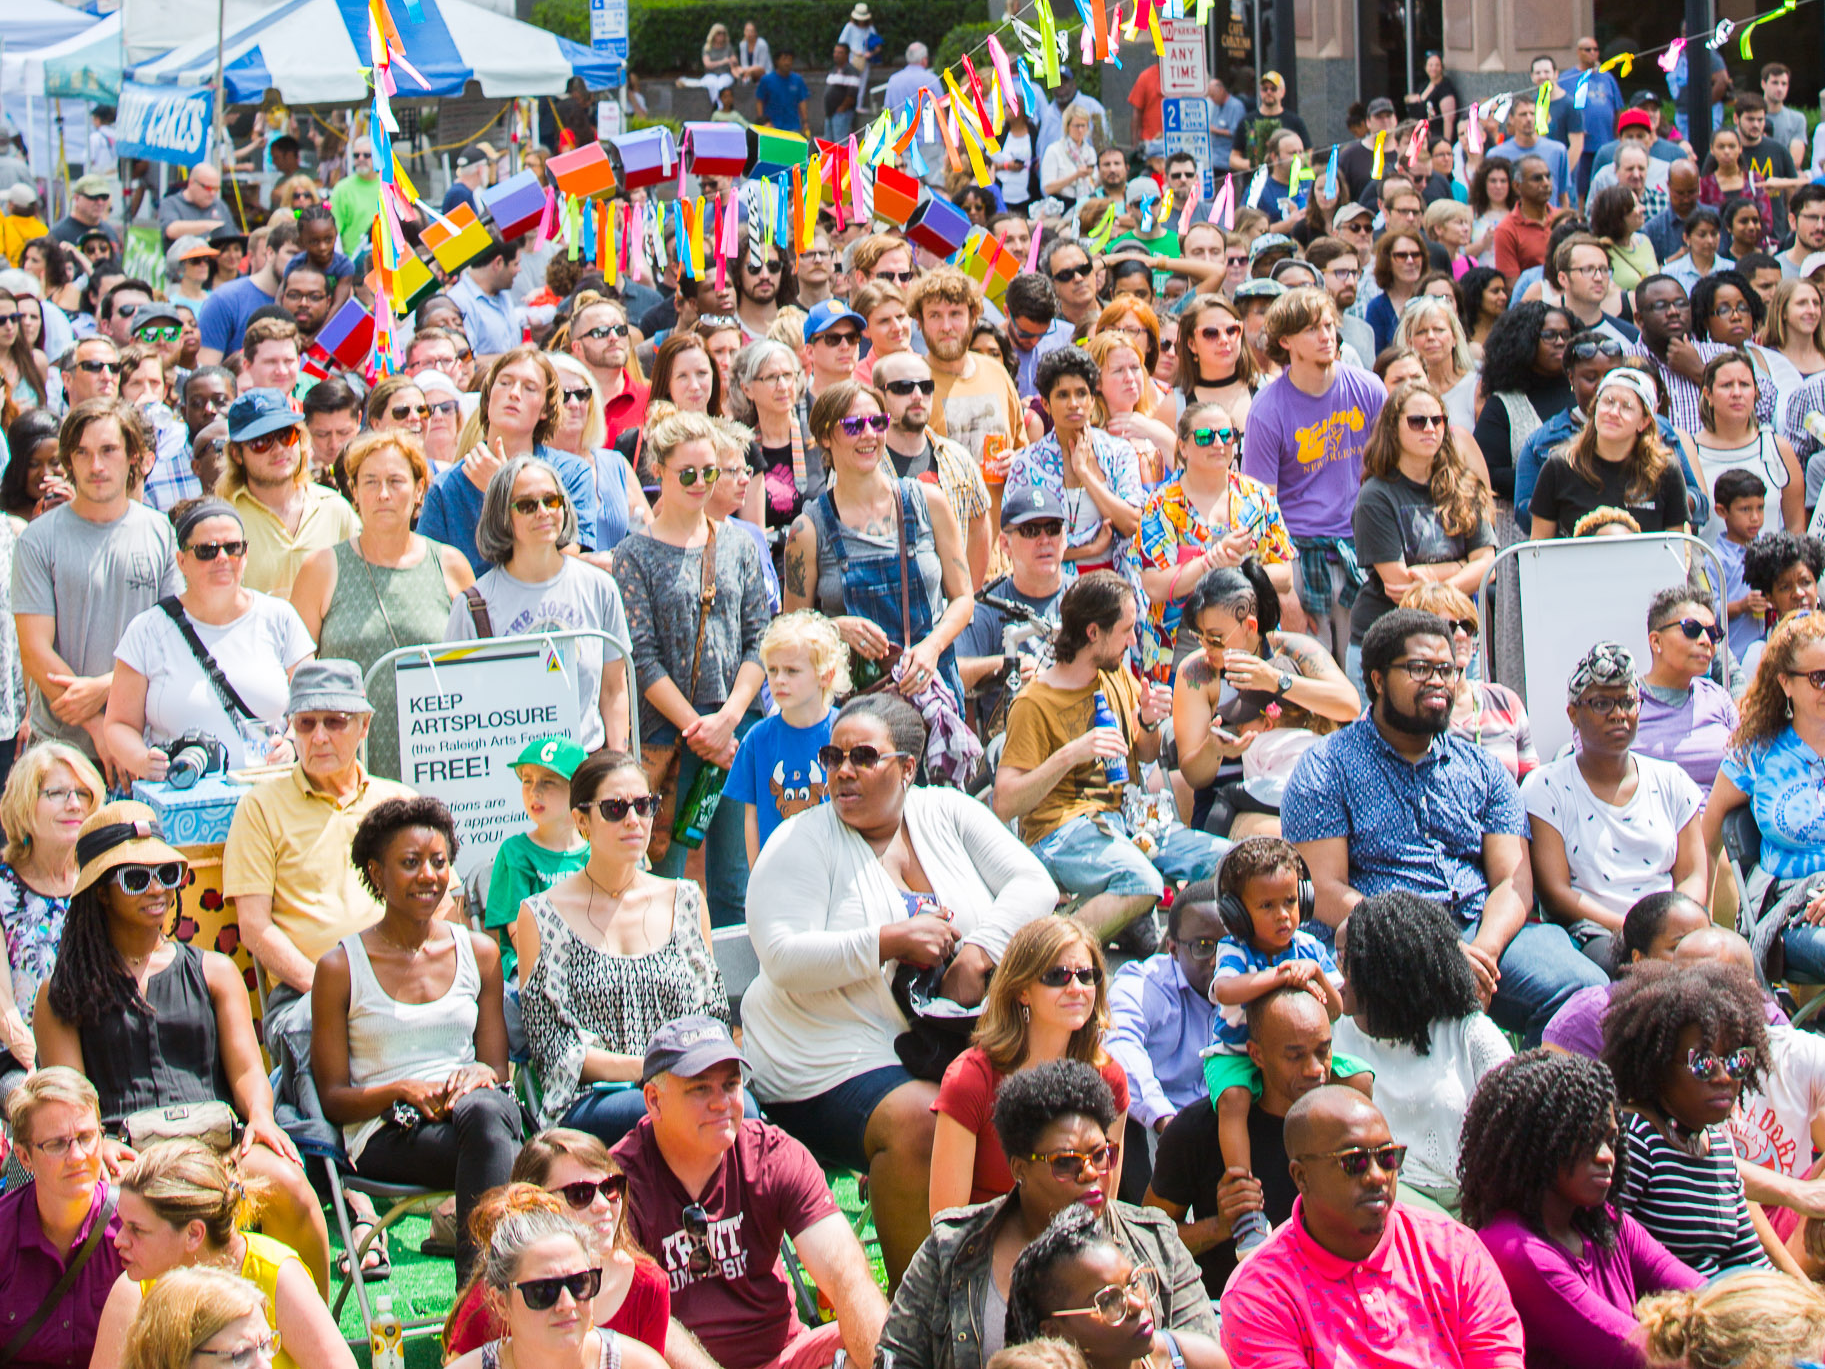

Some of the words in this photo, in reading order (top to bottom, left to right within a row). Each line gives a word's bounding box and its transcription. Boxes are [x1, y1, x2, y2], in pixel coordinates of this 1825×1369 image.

[1170, 47, 1194, 61] ANY
[1169, 65, 1197, 79] TIME
[145, 95, 206, 154] CAKES
[1168, 104, 1176, 127] 2
[1303, 459, 1323, 475] NEW
[409, 693, 463, 714] KEEP
[410, 705, 558, 736] ARTSPLOSURE
[411, 743, 436, 758] (the
[439, 734, 487, 754] Raleigh
[490, 734, 517, 748] Arts
[540, 741, 558, 763] C
[413, 755, 491, 784] FREE!
[484, 798, 506, 810] are
[469, 830, 504, 845] YOU!
